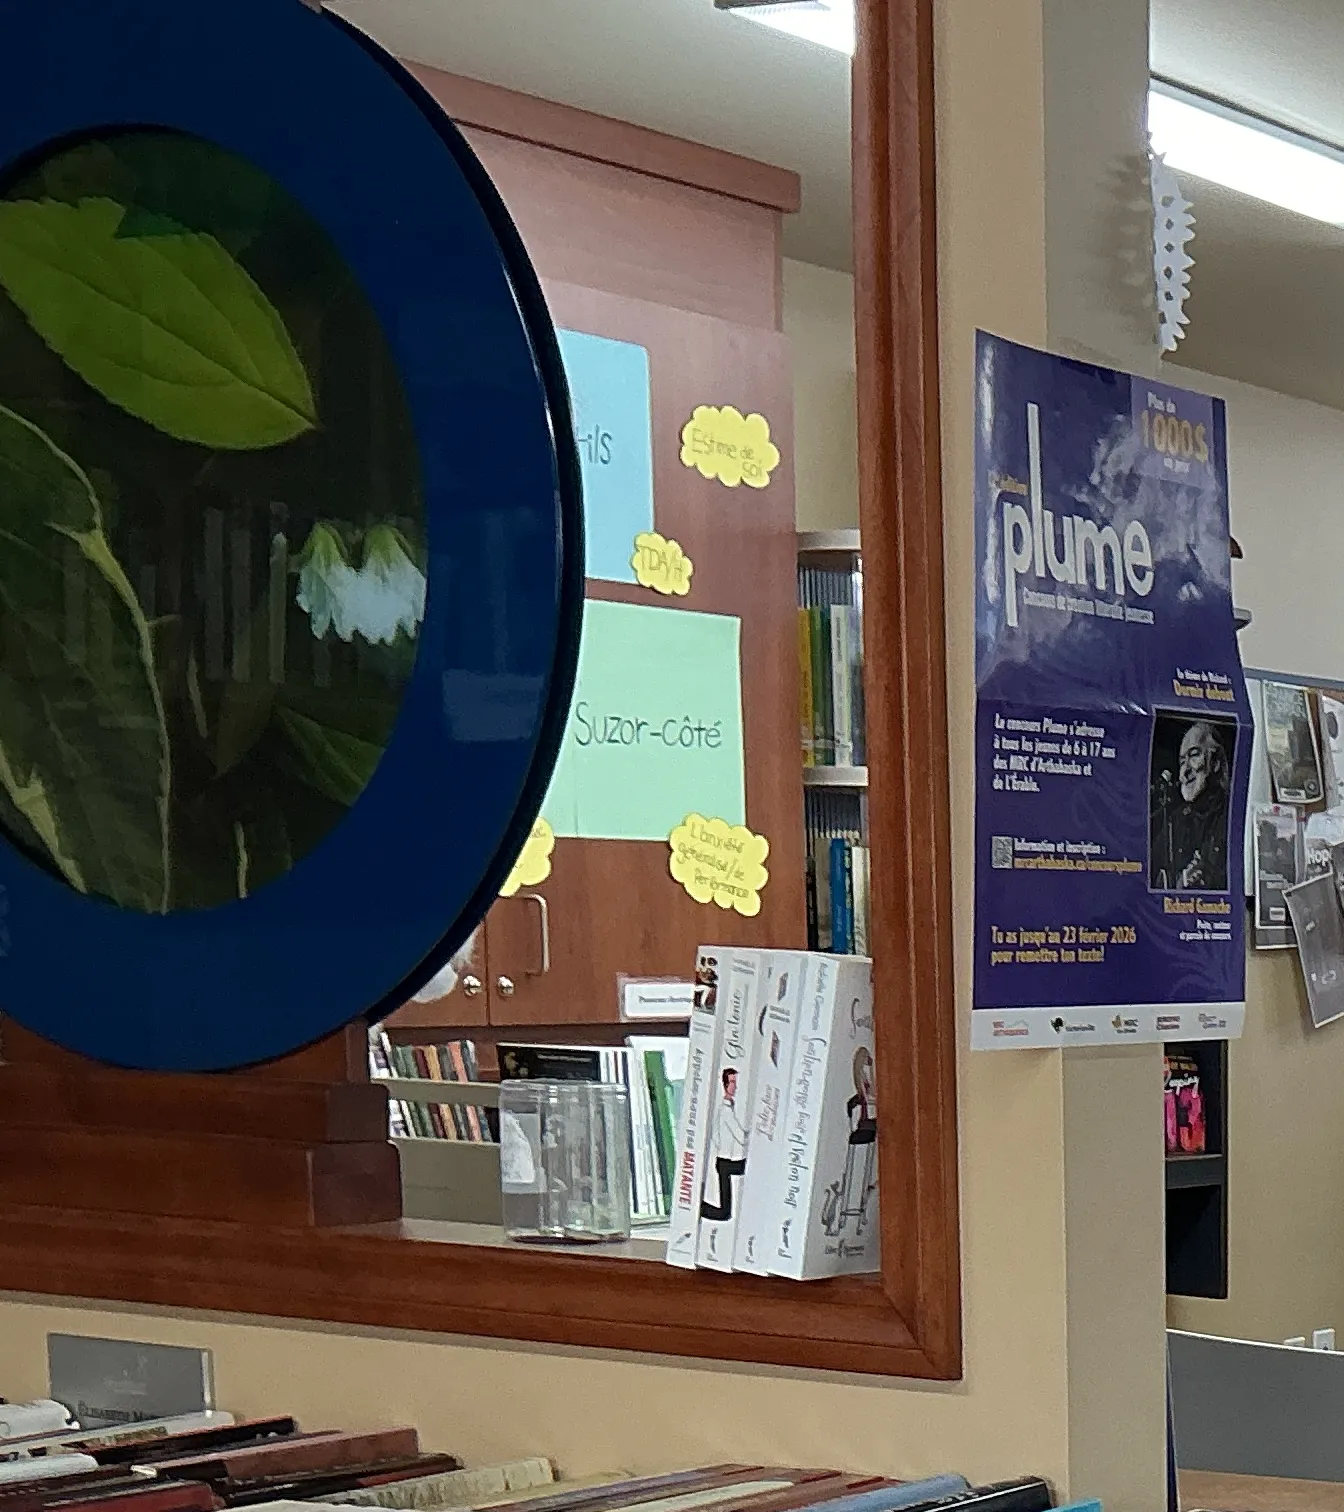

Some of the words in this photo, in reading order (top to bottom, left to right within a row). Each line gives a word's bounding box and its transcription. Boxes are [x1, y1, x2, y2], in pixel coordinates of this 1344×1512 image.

[577, 424, 613, 465] tils
[1003, 401, 1155, 627] plume
[1063, 926, 1076, 944] 23
[1110, 926, 1137, 943] 2026
